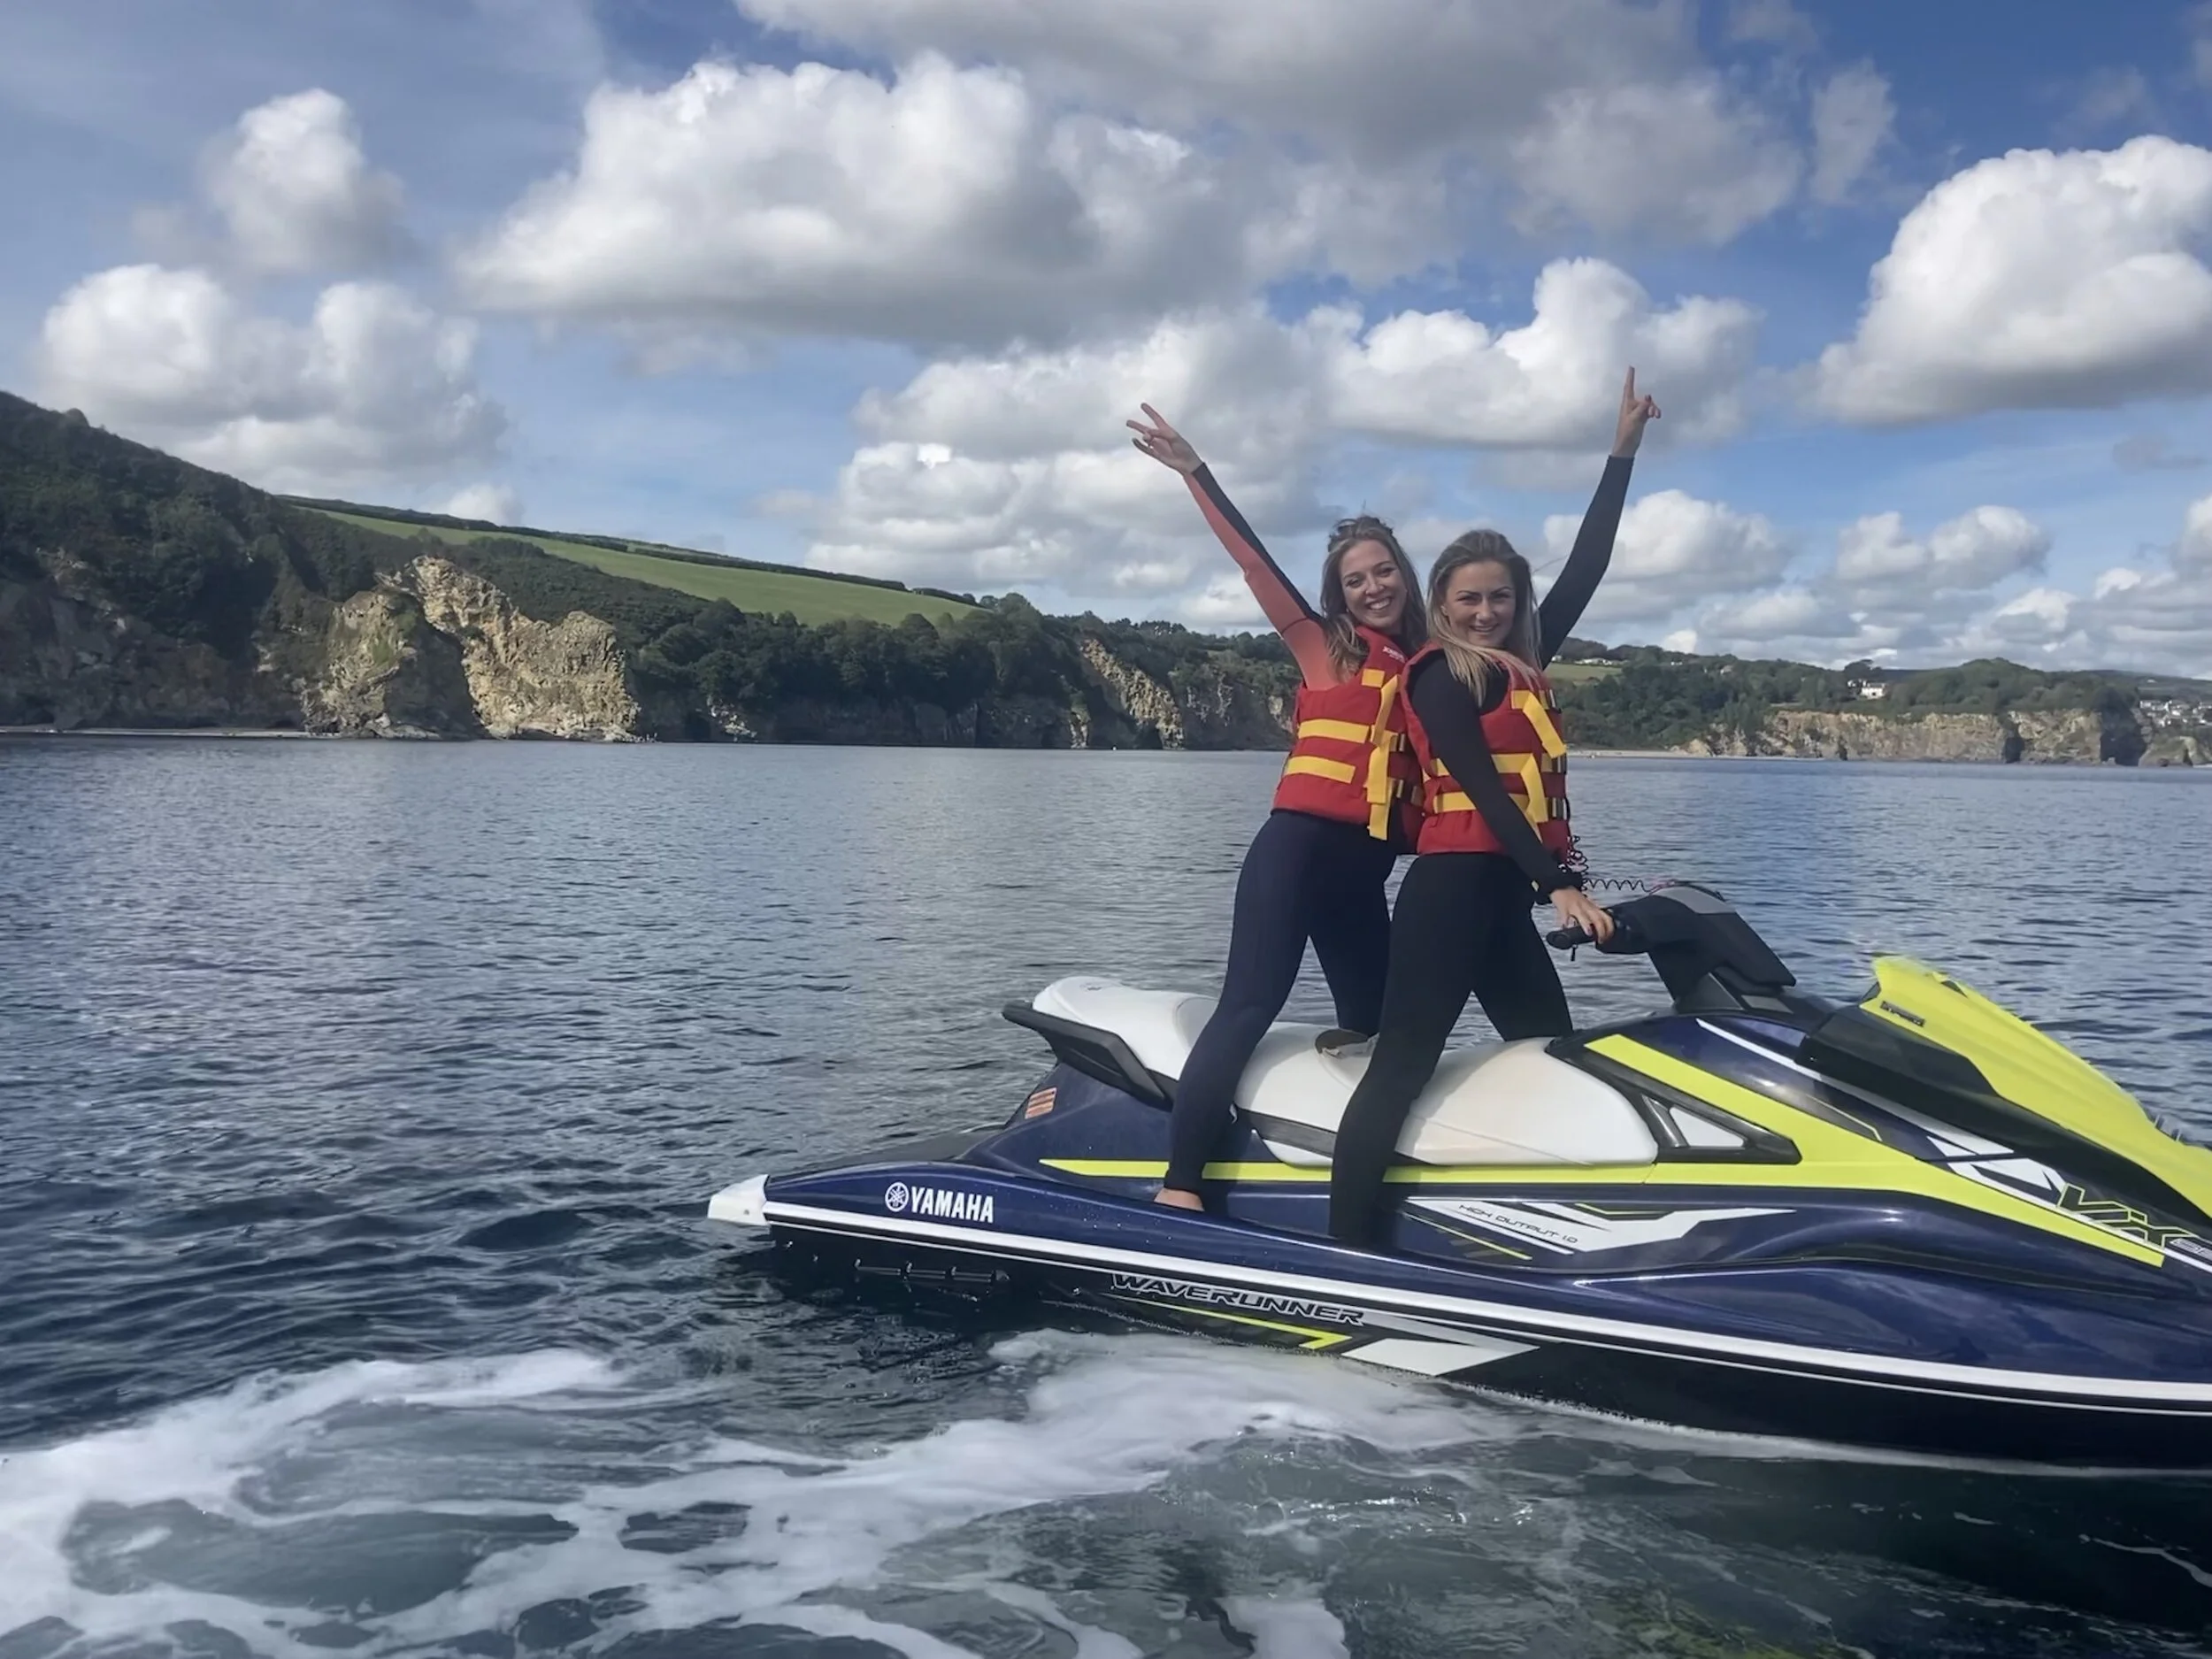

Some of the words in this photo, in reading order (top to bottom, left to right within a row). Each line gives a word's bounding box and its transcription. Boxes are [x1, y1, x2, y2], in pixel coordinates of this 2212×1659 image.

[910, 1186, 994, 1224] YAMAHA
[1495, 1215, 1560, 1236] OUTPUT
[1110, 1272, 1363, 1325] WAVERUNNER
